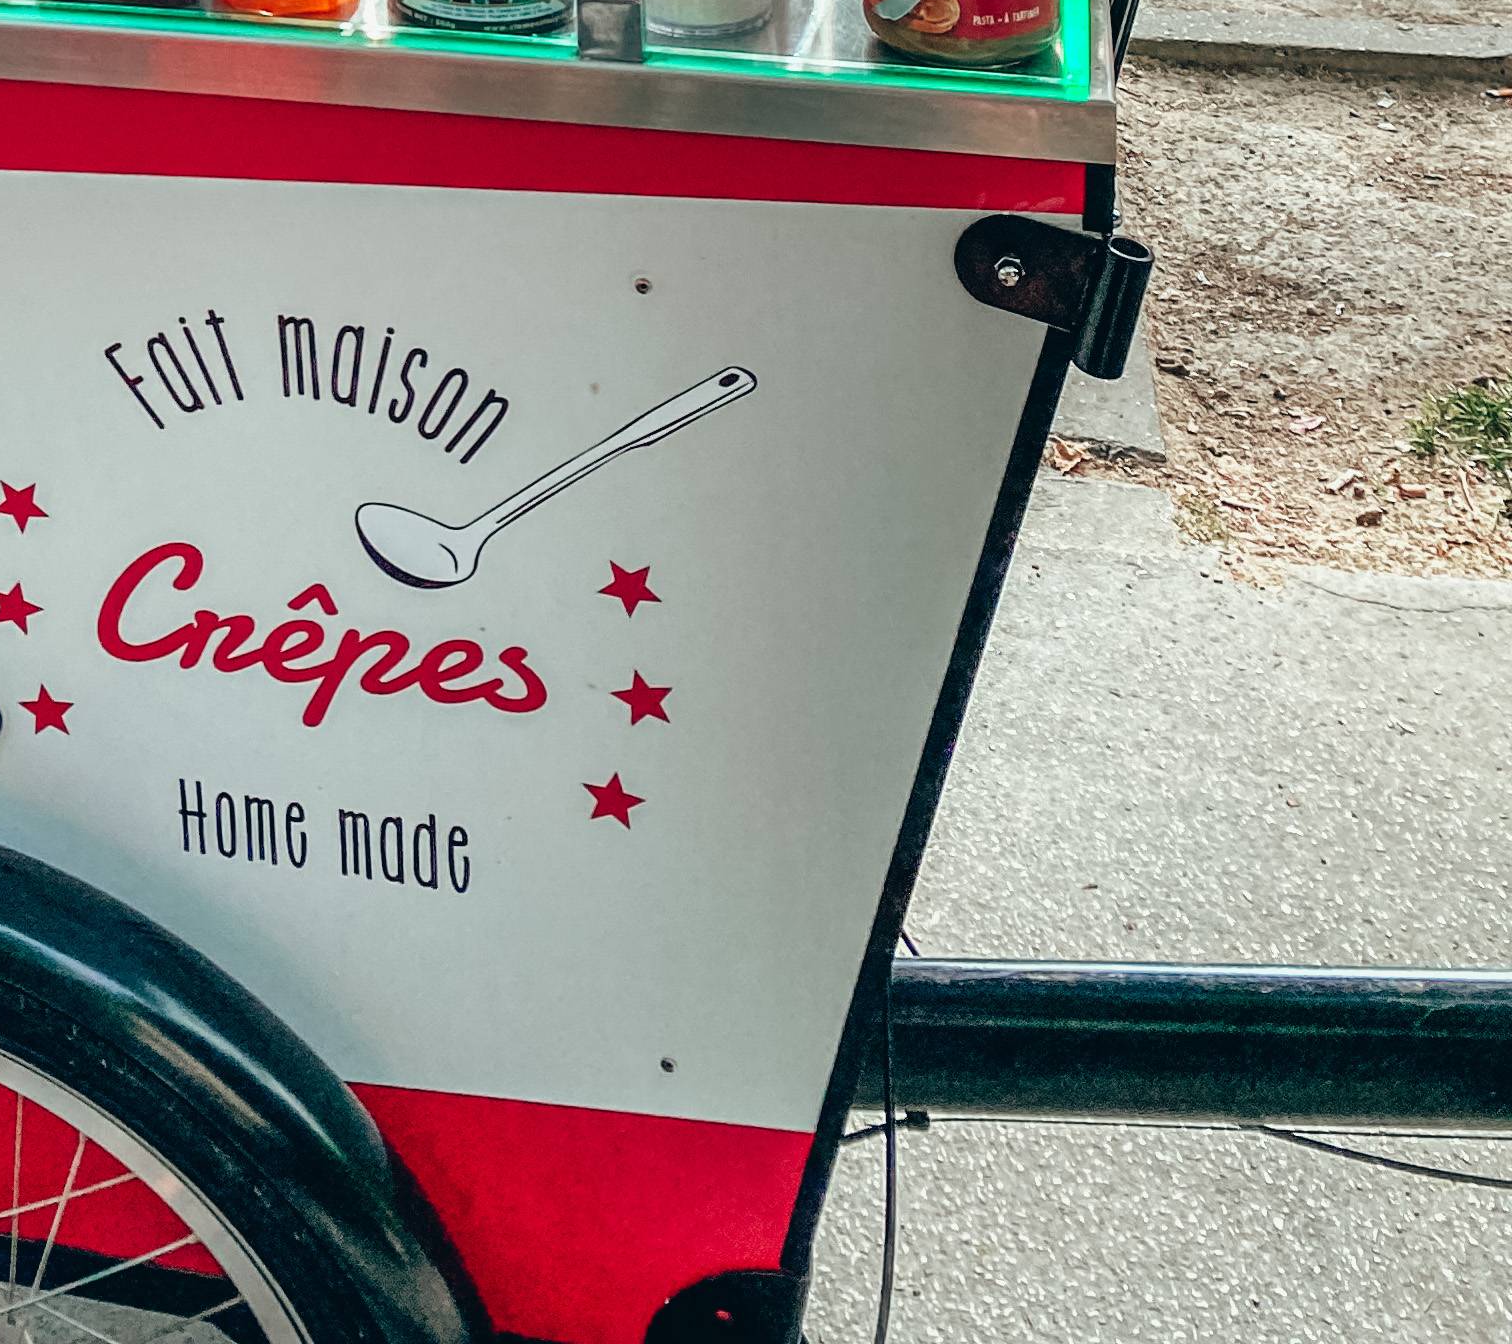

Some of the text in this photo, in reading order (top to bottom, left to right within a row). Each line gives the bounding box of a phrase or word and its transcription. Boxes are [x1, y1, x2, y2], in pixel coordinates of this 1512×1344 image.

[104, 308, 510, 465] Fait maison
[96, 542, 549, 729] Crêpes
[178, 777, 472, 894] Home made
